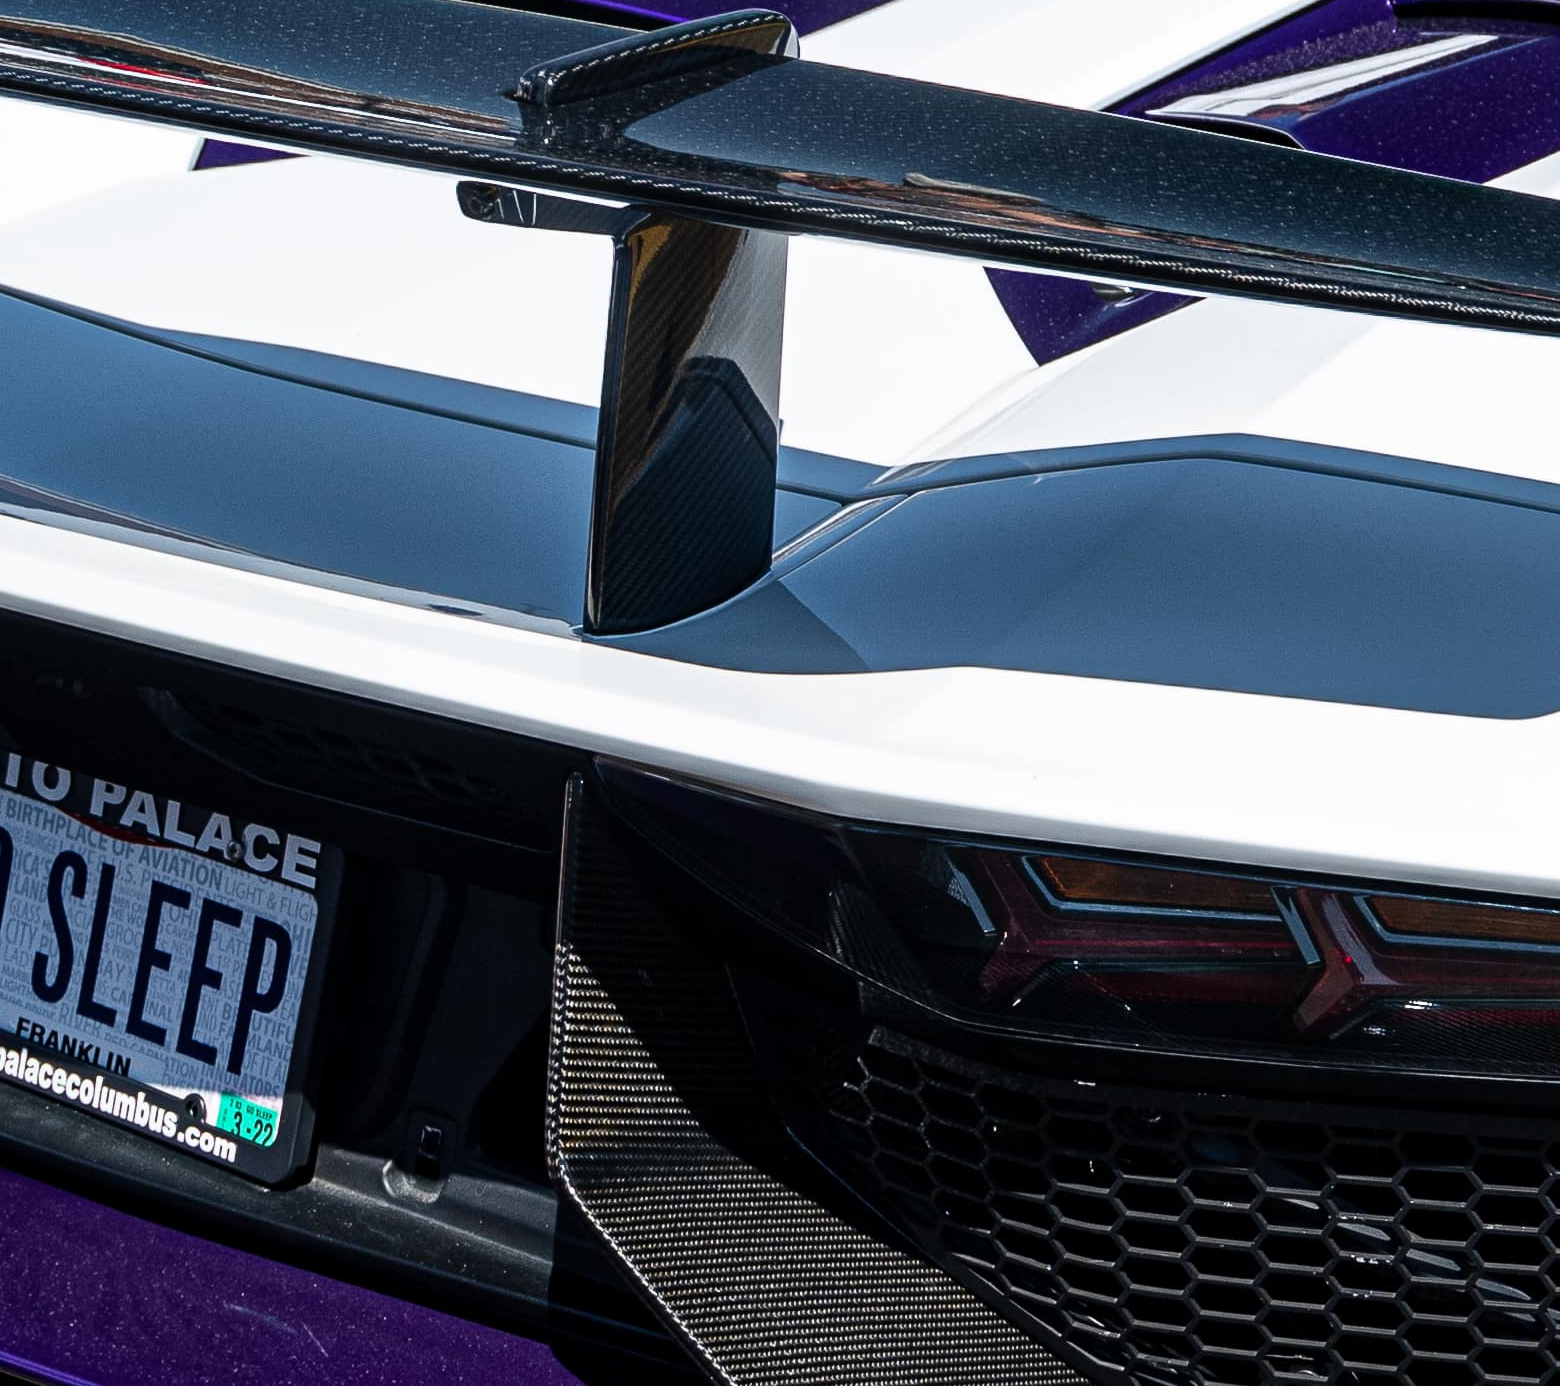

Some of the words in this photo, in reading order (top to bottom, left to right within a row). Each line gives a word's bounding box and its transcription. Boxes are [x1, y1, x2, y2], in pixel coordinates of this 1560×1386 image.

[4, 797, 110, 851] BIRTHPLACE
[137, 842, 224, 892] AVIATION
[89, 778, 322, 889] PALACE
[31, 850, 293, 1076] SLEEP
[16, 1016, 132, 1077] FRANKLIN
